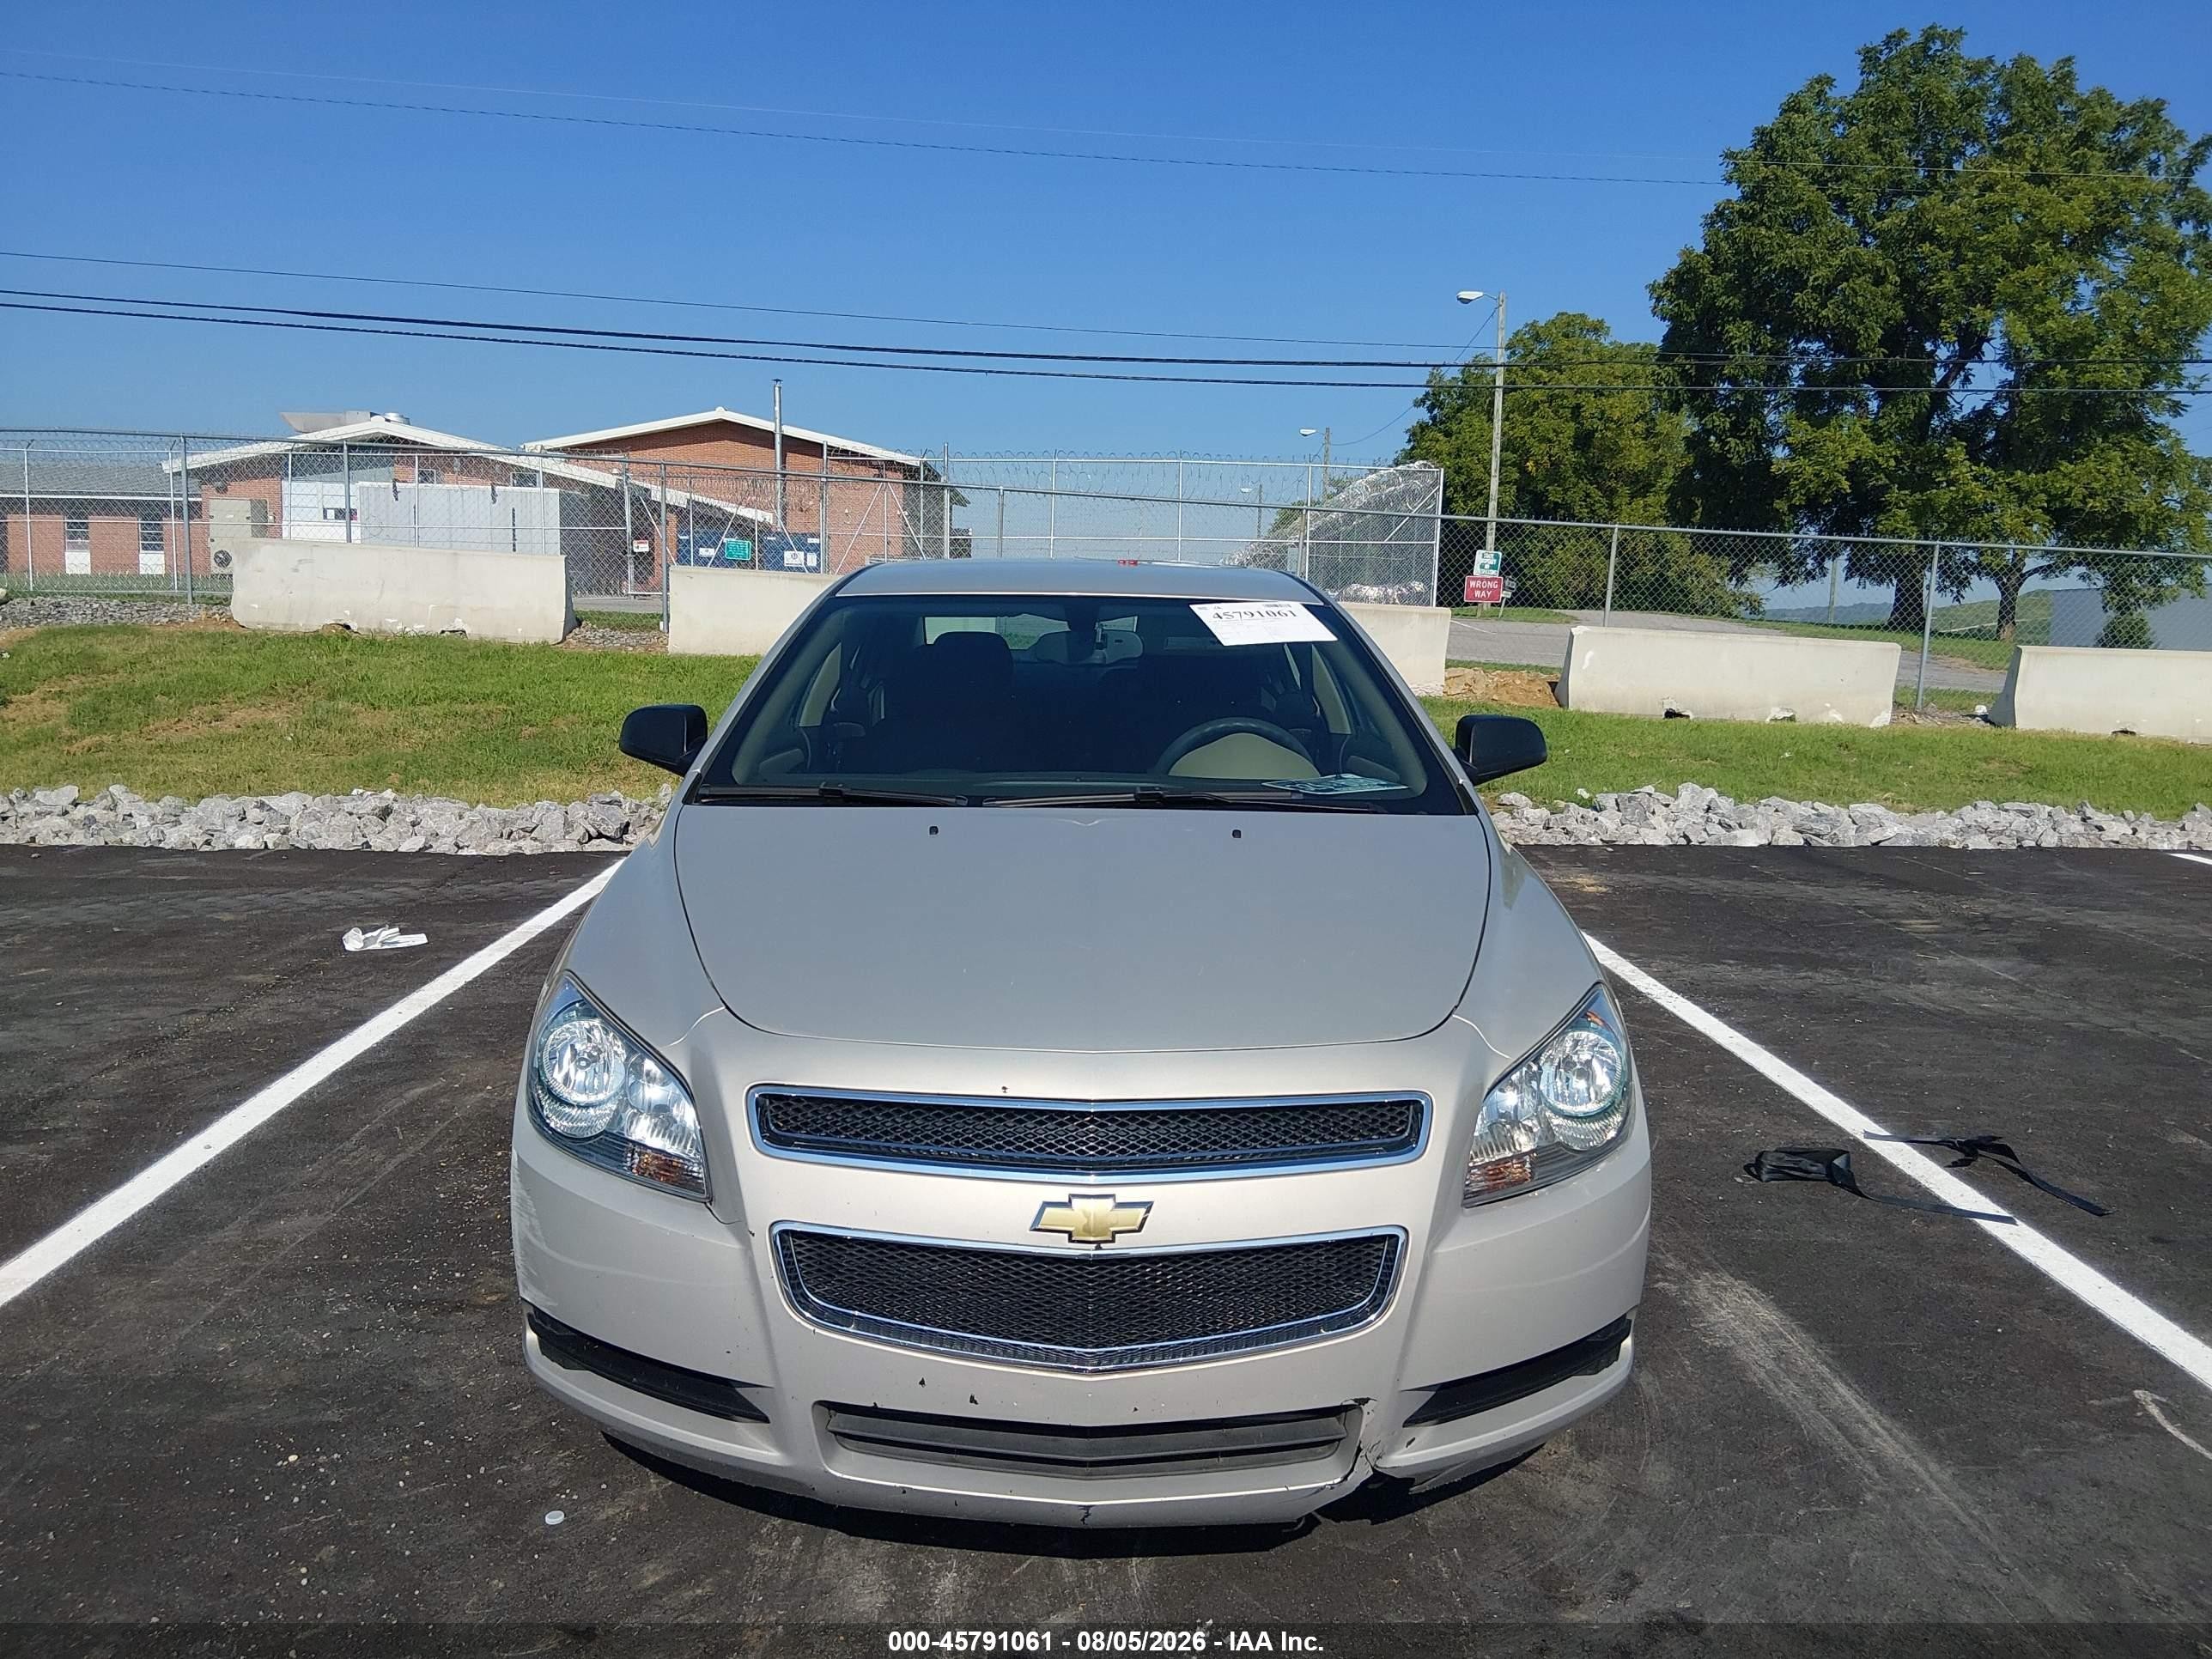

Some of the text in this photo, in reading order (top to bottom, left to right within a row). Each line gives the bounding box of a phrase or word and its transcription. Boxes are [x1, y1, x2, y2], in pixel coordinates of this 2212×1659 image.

[1469, 580, 1498, 589] WRONG
[1474, 590, 1492, 599] WAY
[1212, 610, 1297, 622] 45791061
